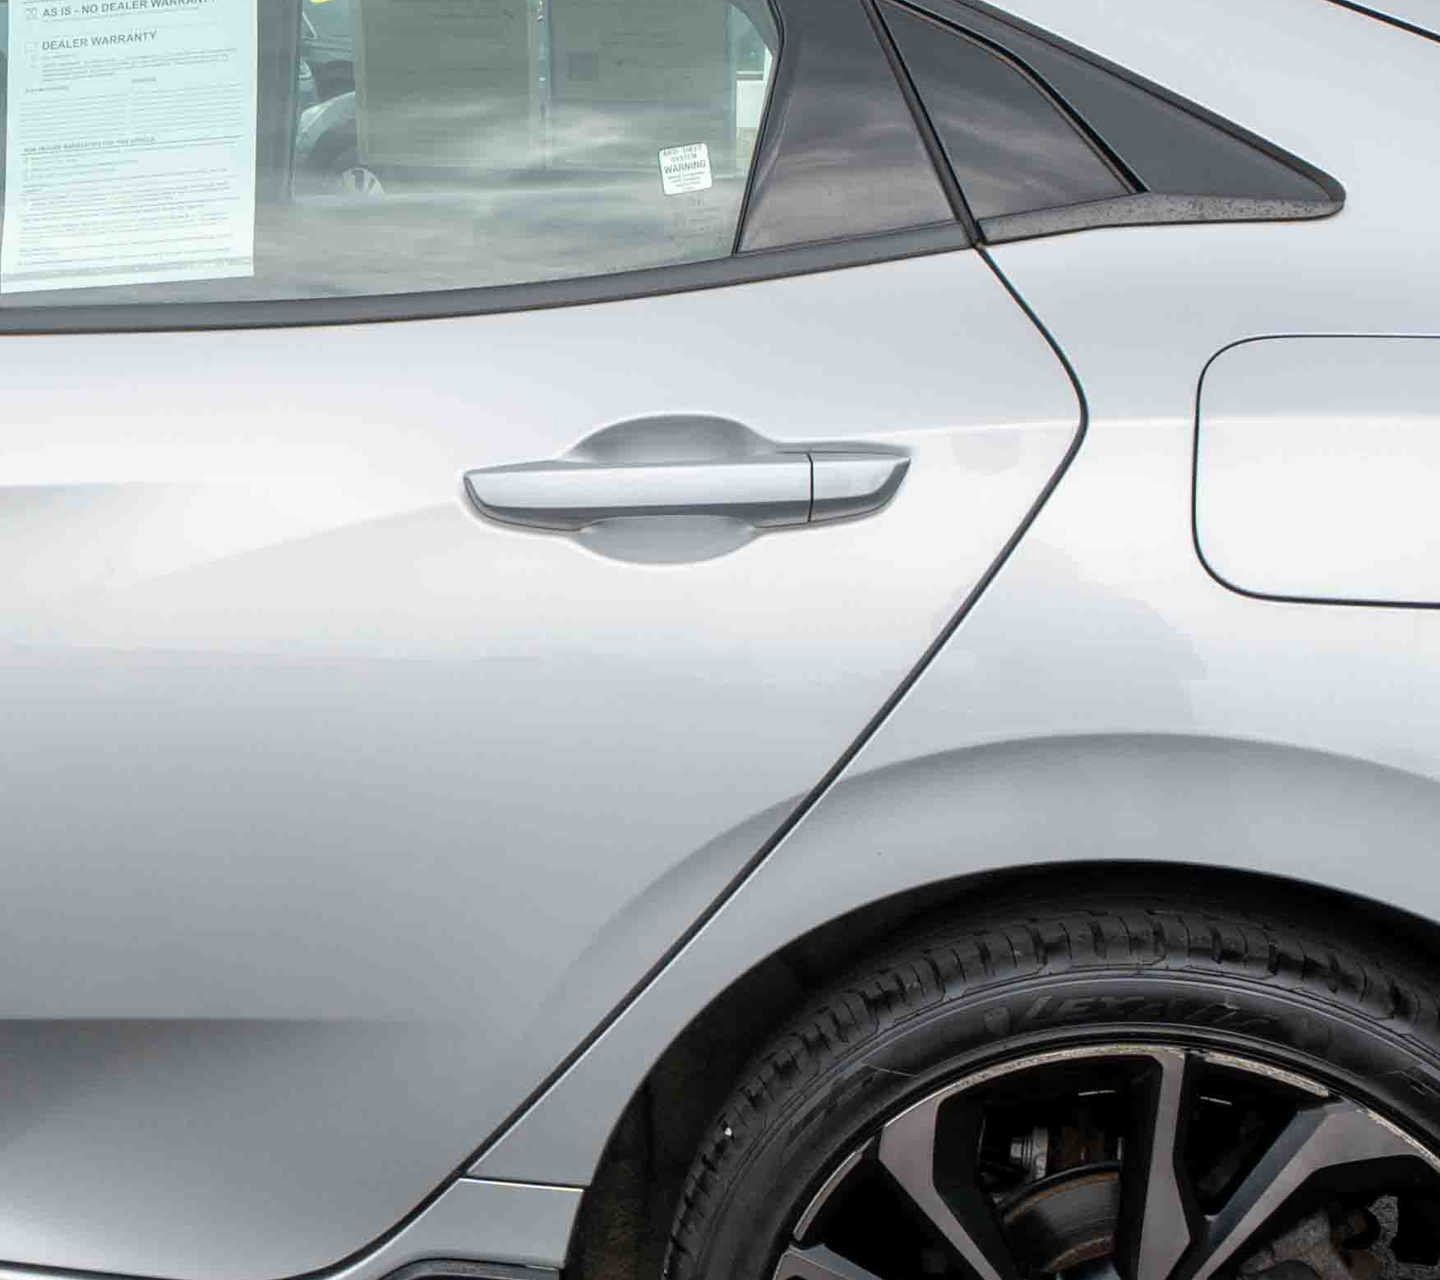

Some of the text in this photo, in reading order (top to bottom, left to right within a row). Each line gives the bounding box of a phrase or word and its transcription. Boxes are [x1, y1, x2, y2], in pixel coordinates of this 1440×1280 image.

[42, 7, 58, 18] AS
[61, 6, 72, 16] IS
[81, 3, 99, 15] NO
[100, 0, 148, 13] DEALER
[42, 30, 157, 51] DEALER WARRANTY
